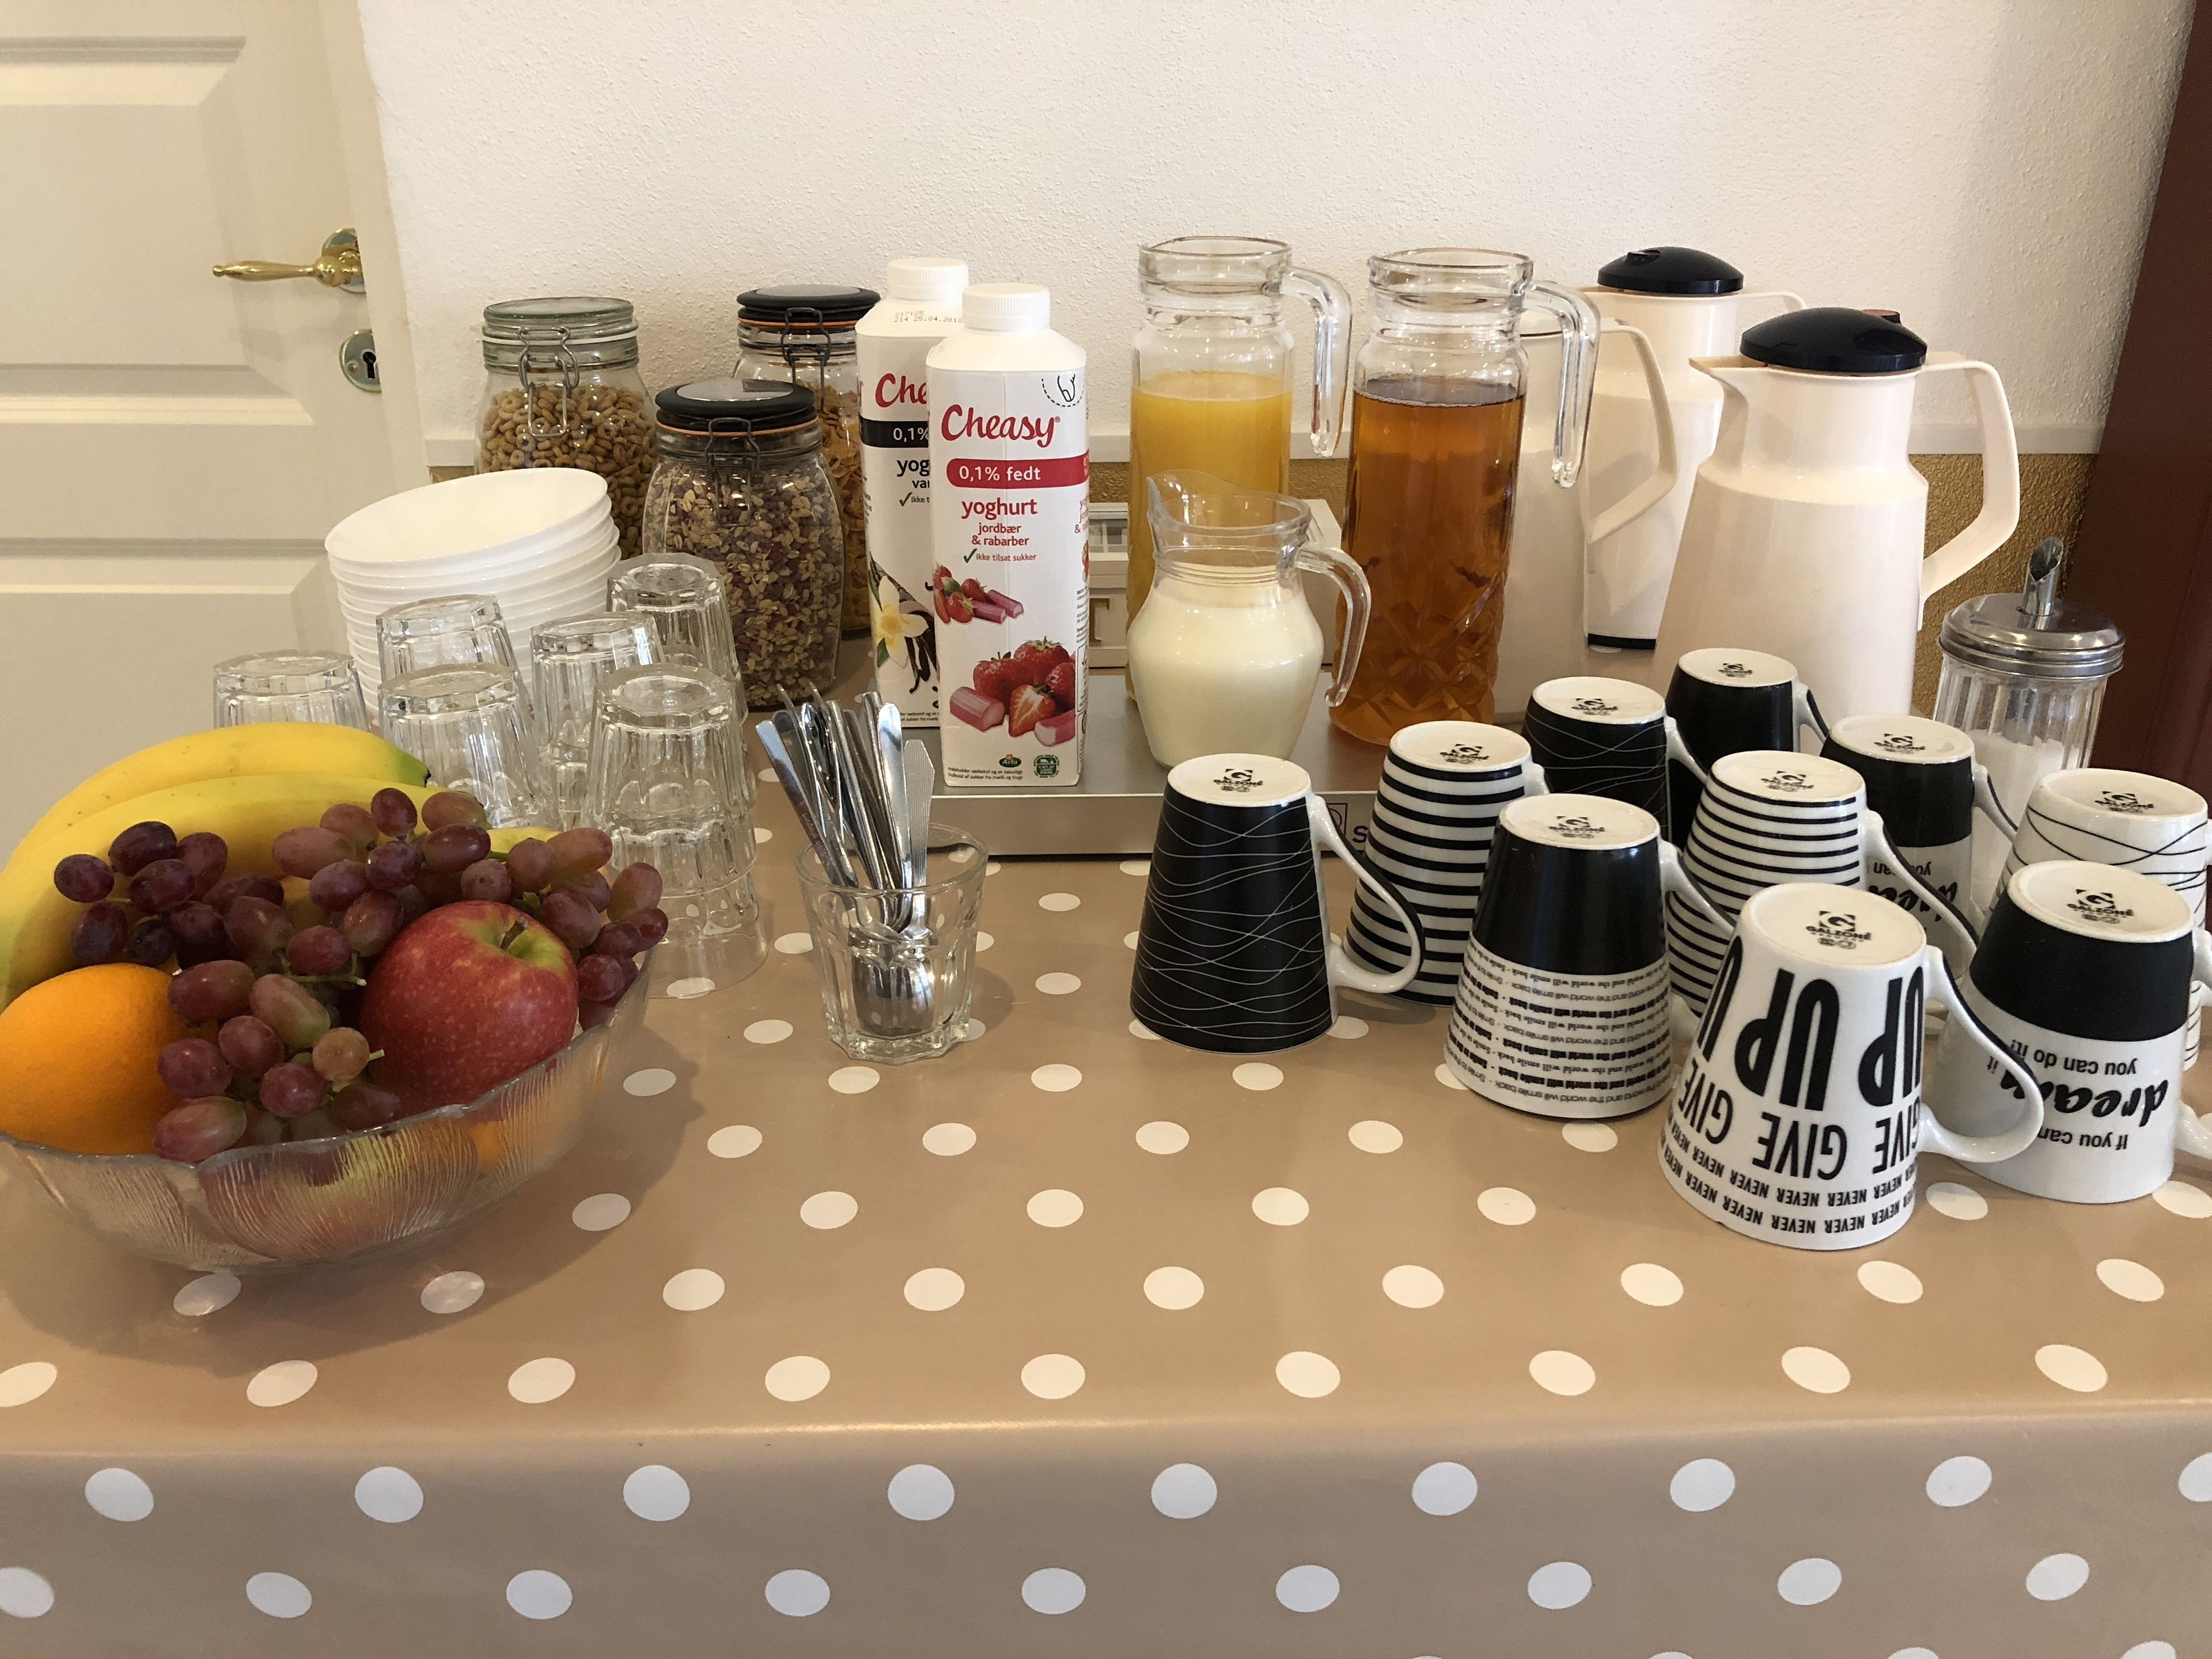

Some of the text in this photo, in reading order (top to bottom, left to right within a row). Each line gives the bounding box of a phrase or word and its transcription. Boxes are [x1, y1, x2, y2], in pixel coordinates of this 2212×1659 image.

[875, 373, 927, 408] Che
[941, 404, 1054, 448] Cheasy
[896, 459, 930, 477] yog
[959, 465, 1041, 481] 0,1% fedt
[961, 498, 1037, 520] yoghurt
[978, 522, 1021, 535] jordbær
[972, 535, 1029, 546] & rabarber
[992, 553, 1011, 561] tilsat
[1505, 1010, 1521, 1021] back
[1524, 1017, 1546, 1025] smile
[1734, 968, 1840, 1111] UP
[1857, 967, 1923, 1108] UP
[1498, 1052, 1514, 1063] back
[1517, 1059, 1540, 1067] smile
[2033, 1050, 2057, 1068] do
[2064, 1058, 2099, 1074] can
[2105, 1058, 2138, 1075] you
[1496, 1081, 1517, 1093] back
[1518, 1088, 1543, 1097] smile
[1677, 1058, 1920, 1180] GIVE GIVE GIVE
[2037, 1127, 2128, 1150] If you can
[1692, 1147, 1725, 1177] NEVER
[1685, 1173, 1718, 1203] NEVER
[1729, 1170, 1769, 1198] NEVER
[1873, 1176, 1902, 1199] NEVER
[1776, 1188, 1820, 1207] NEVER
[1827, 1189, 1867, 1207] NEVER
[1722, 1196, 1763, 1225] NEVER
[1872, 1202, 1900, 1225] NEVER
[1771, 1215, 1816, 1234] NEVER
[1824, 1215, 1865, 1233] NEVER
